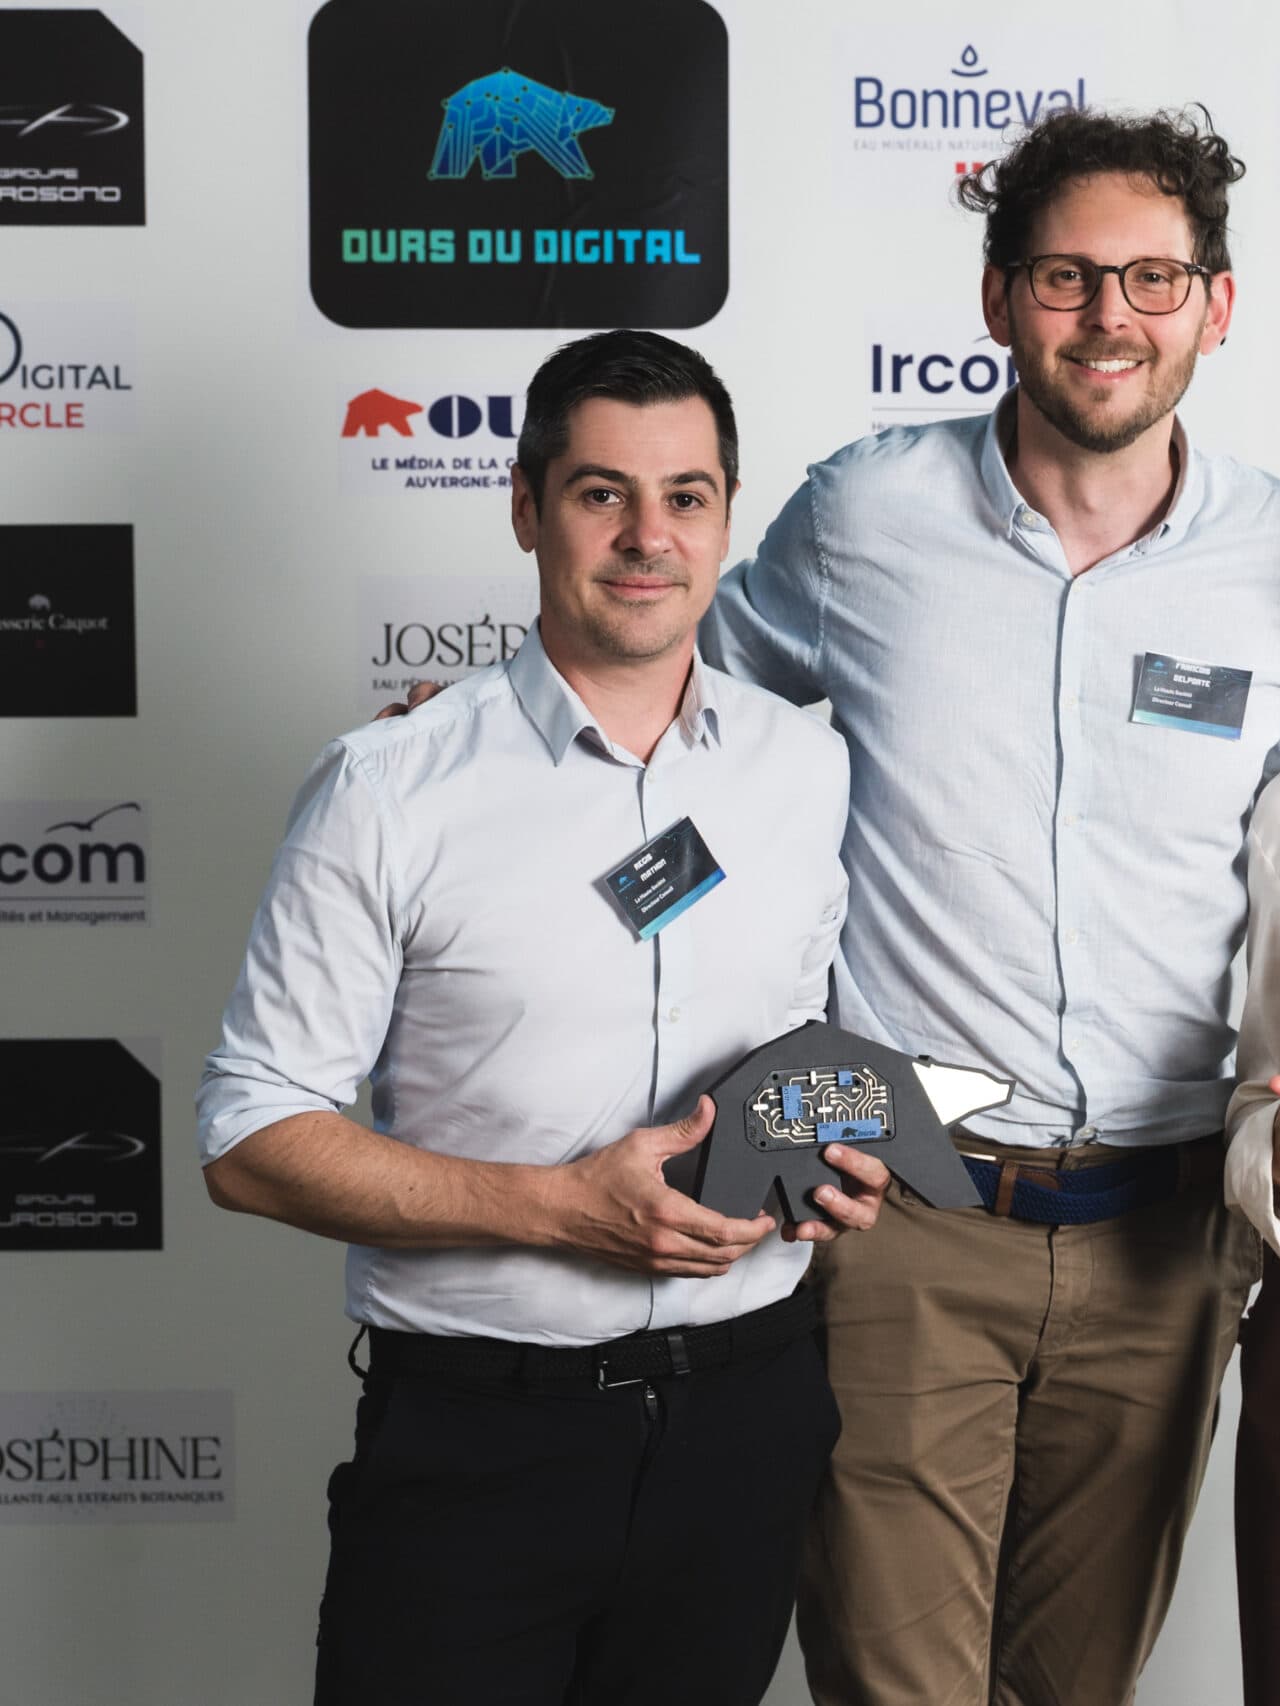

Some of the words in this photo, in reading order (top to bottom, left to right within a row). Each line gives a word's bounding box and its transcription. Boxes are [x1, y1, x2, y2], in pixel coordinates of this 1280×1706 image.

[854, 77, 1085, 129] Bonneval
[343, 229, 455, 263] OURS
[468, 229, 521, 263] DU
[535, 229, 701, 263] DIGITAL
[872, 344, 1017, 394] Irco
[372, 458, 388, 470] LE
[396, 455, 444, 470] MÉDIA
[453, 458, 471, 469] DE
[479, 458, 497, 469] LA
[0, 1428, 222, 1482] SÉPHINE
